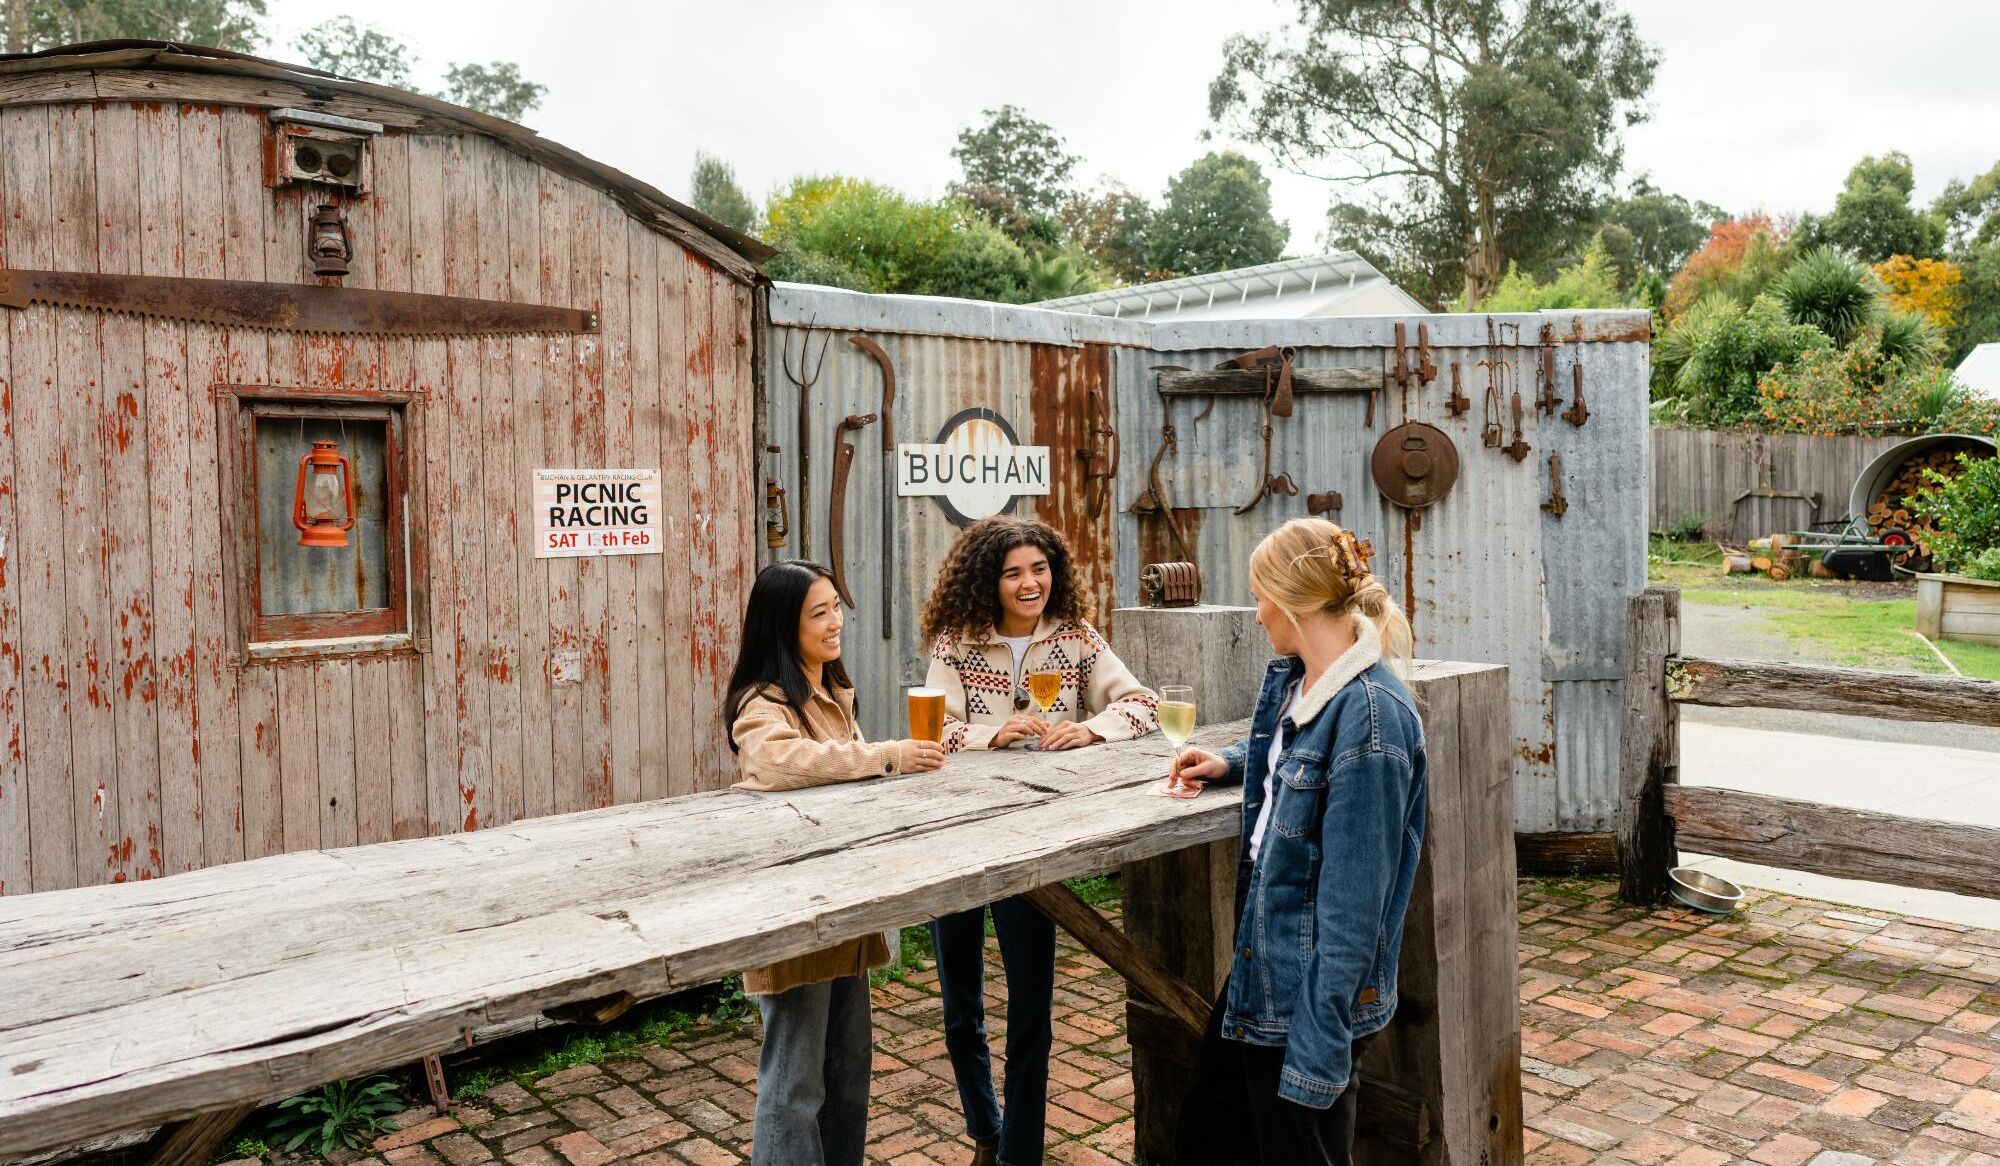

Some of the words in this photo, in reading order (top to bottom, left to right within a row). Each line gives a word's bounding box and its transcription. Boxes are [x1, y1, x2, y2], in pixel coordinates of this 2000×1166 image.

[909, 454, 1042, 484] BUCHAN
[556, 483, 641, 504] PICNIC
[549, 506, 648, 528] RACING
[549, 533, 579, 549] SAT
[622, 530, 650, 546] Feb
